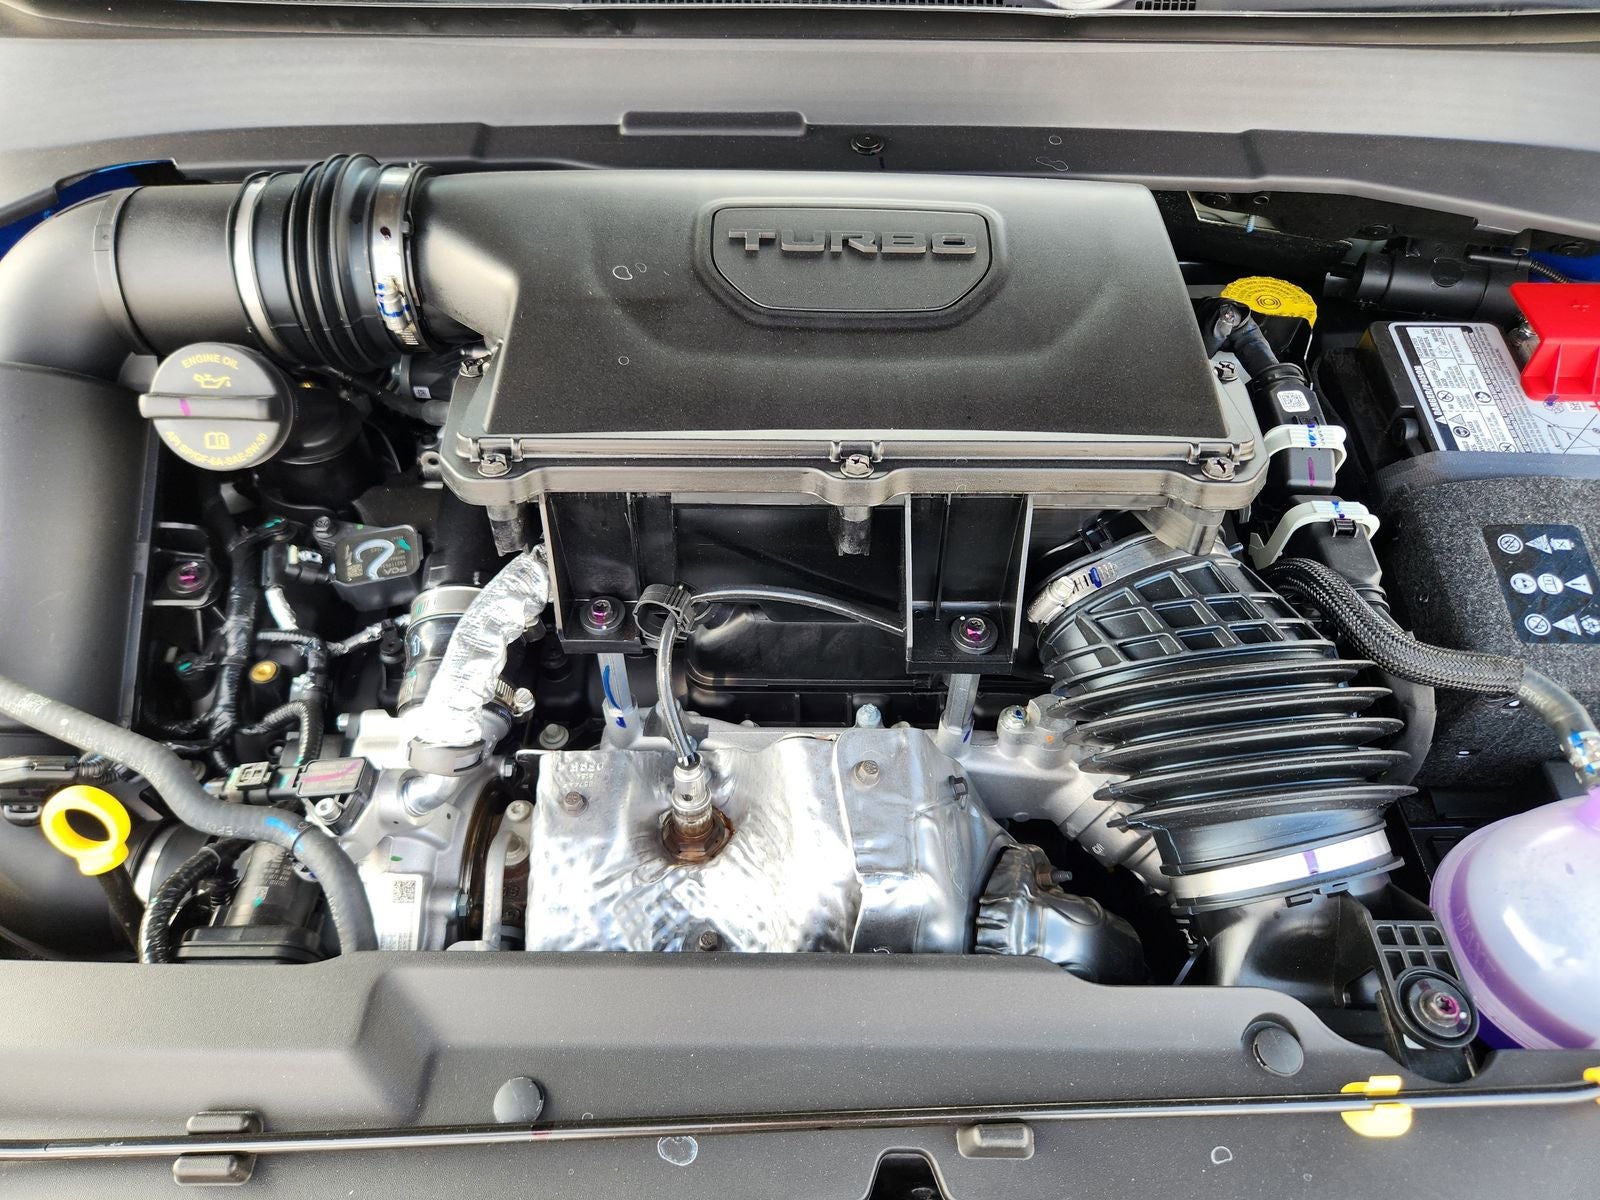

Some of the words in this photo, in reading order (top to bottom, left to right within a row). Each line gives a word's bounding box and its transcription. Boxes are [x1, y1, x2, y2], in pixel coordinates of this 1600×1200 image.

[729, 229, 976, 254] TURBO
[181, 354, 220, 369] ENGINE
[223, 356, 239, 370] OIL
[1414, 365, 1442, 416] DANGER/POISON
[165, 431, 180, 447] API
